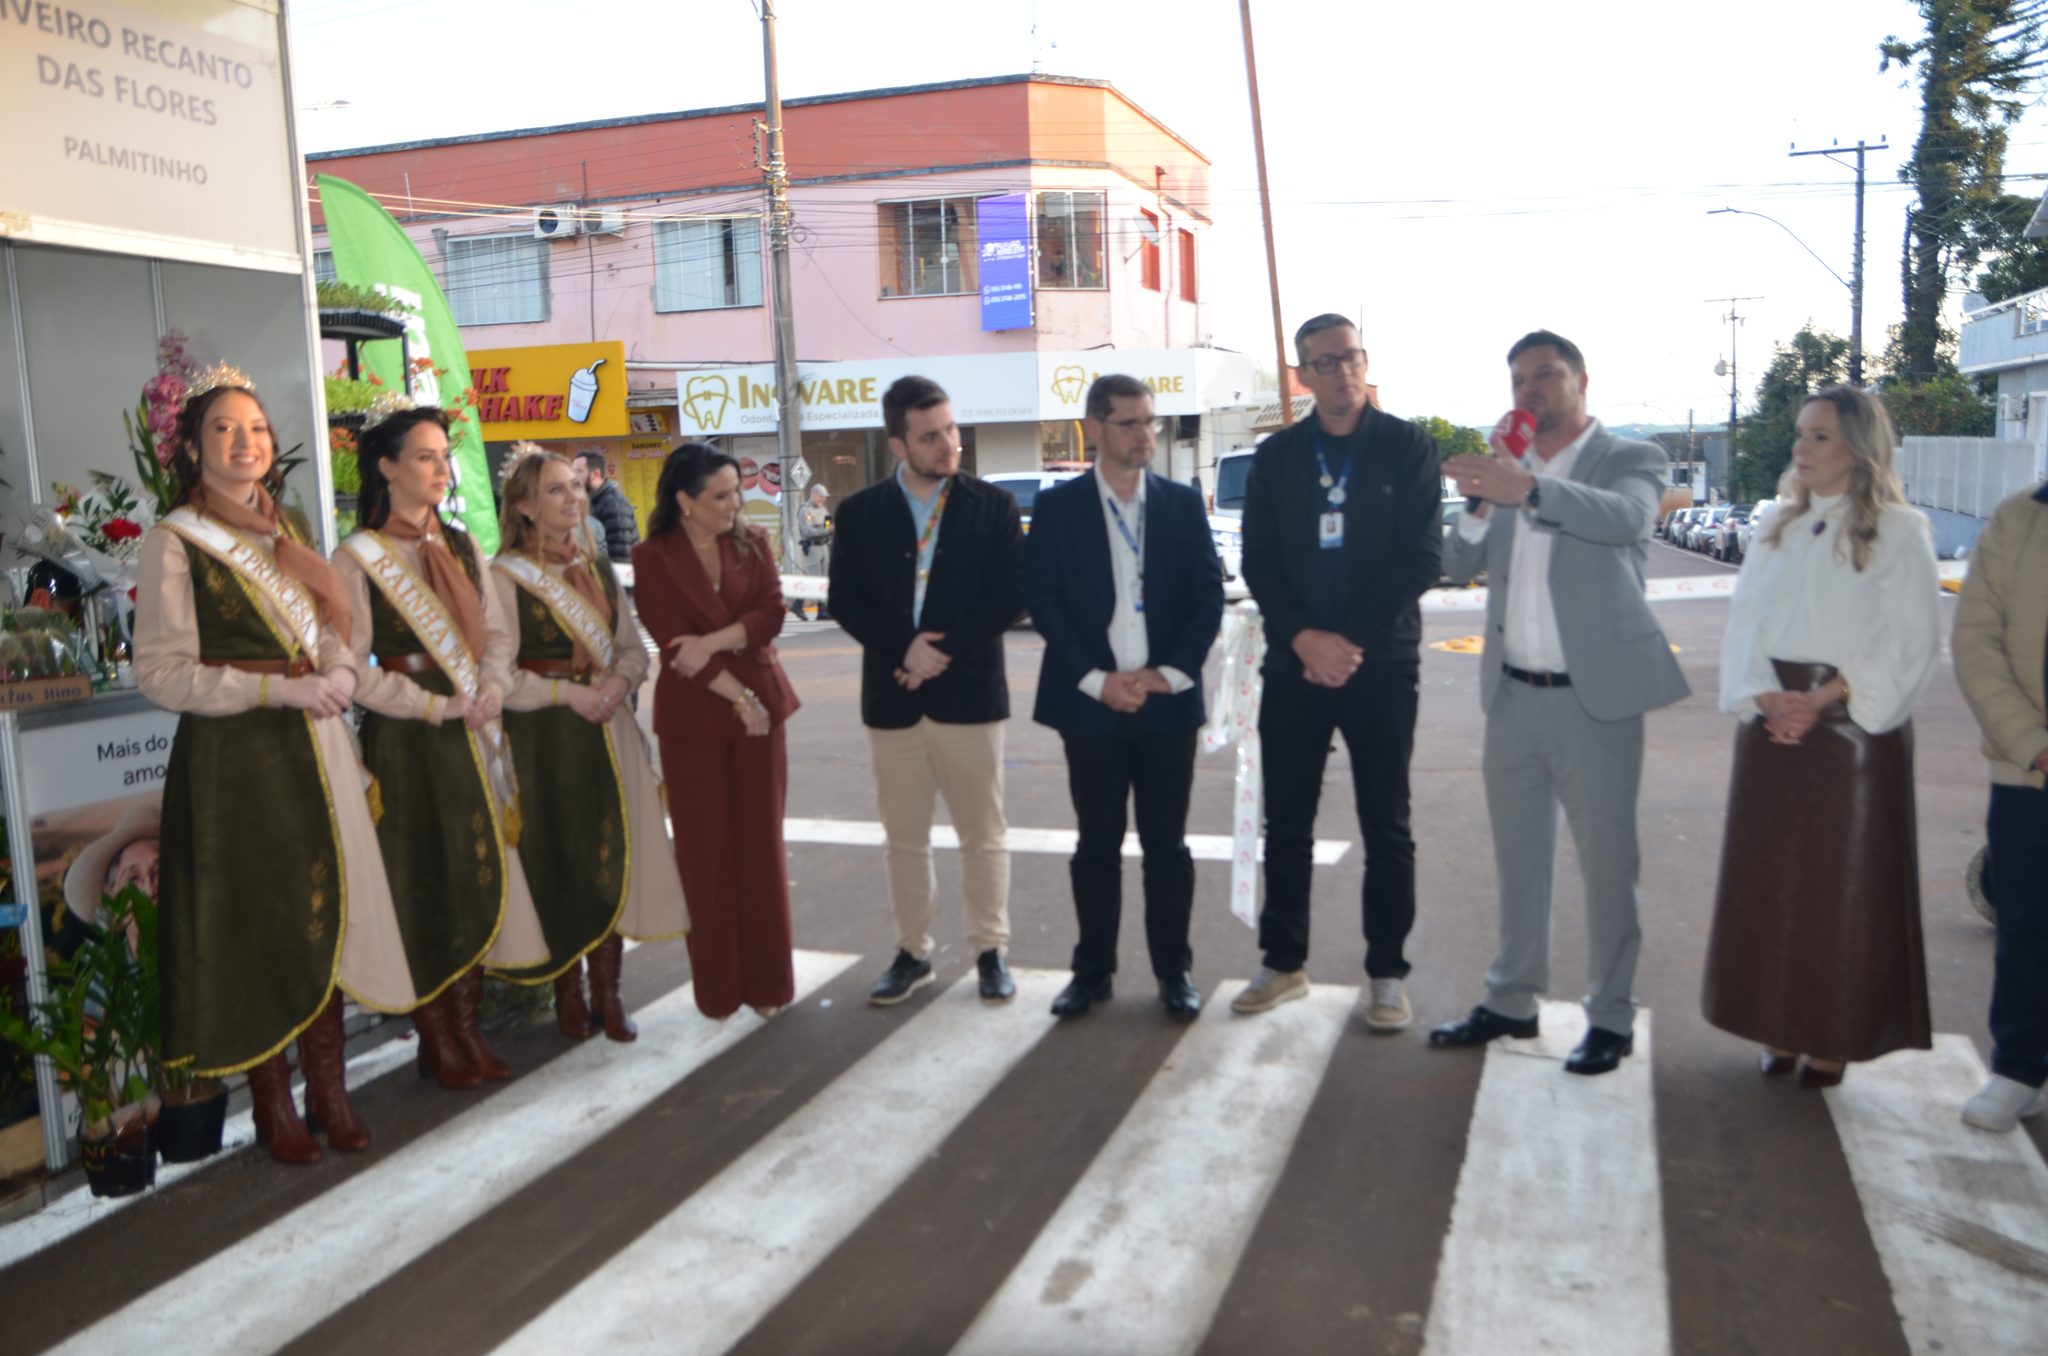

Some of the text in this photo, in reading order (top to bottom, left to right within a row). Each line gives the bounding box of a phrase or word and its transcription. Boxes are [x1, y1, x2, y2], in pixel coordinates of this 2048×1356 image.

[121, 27, 253, 89] RECANTO
[37, 54, 218, 126] DAS FLORES
[64, 136, 208, 185] PALMITINHO
[470, 366, 511, 393] LK
[738, 375, 878, 410] INVARE
[477, 394, 564, 423] HAKE
[807, 409, 880, 422] Especializada
[372, 554, 450, 646] RAINHA
[97, 734, 169, 762] Mais do
